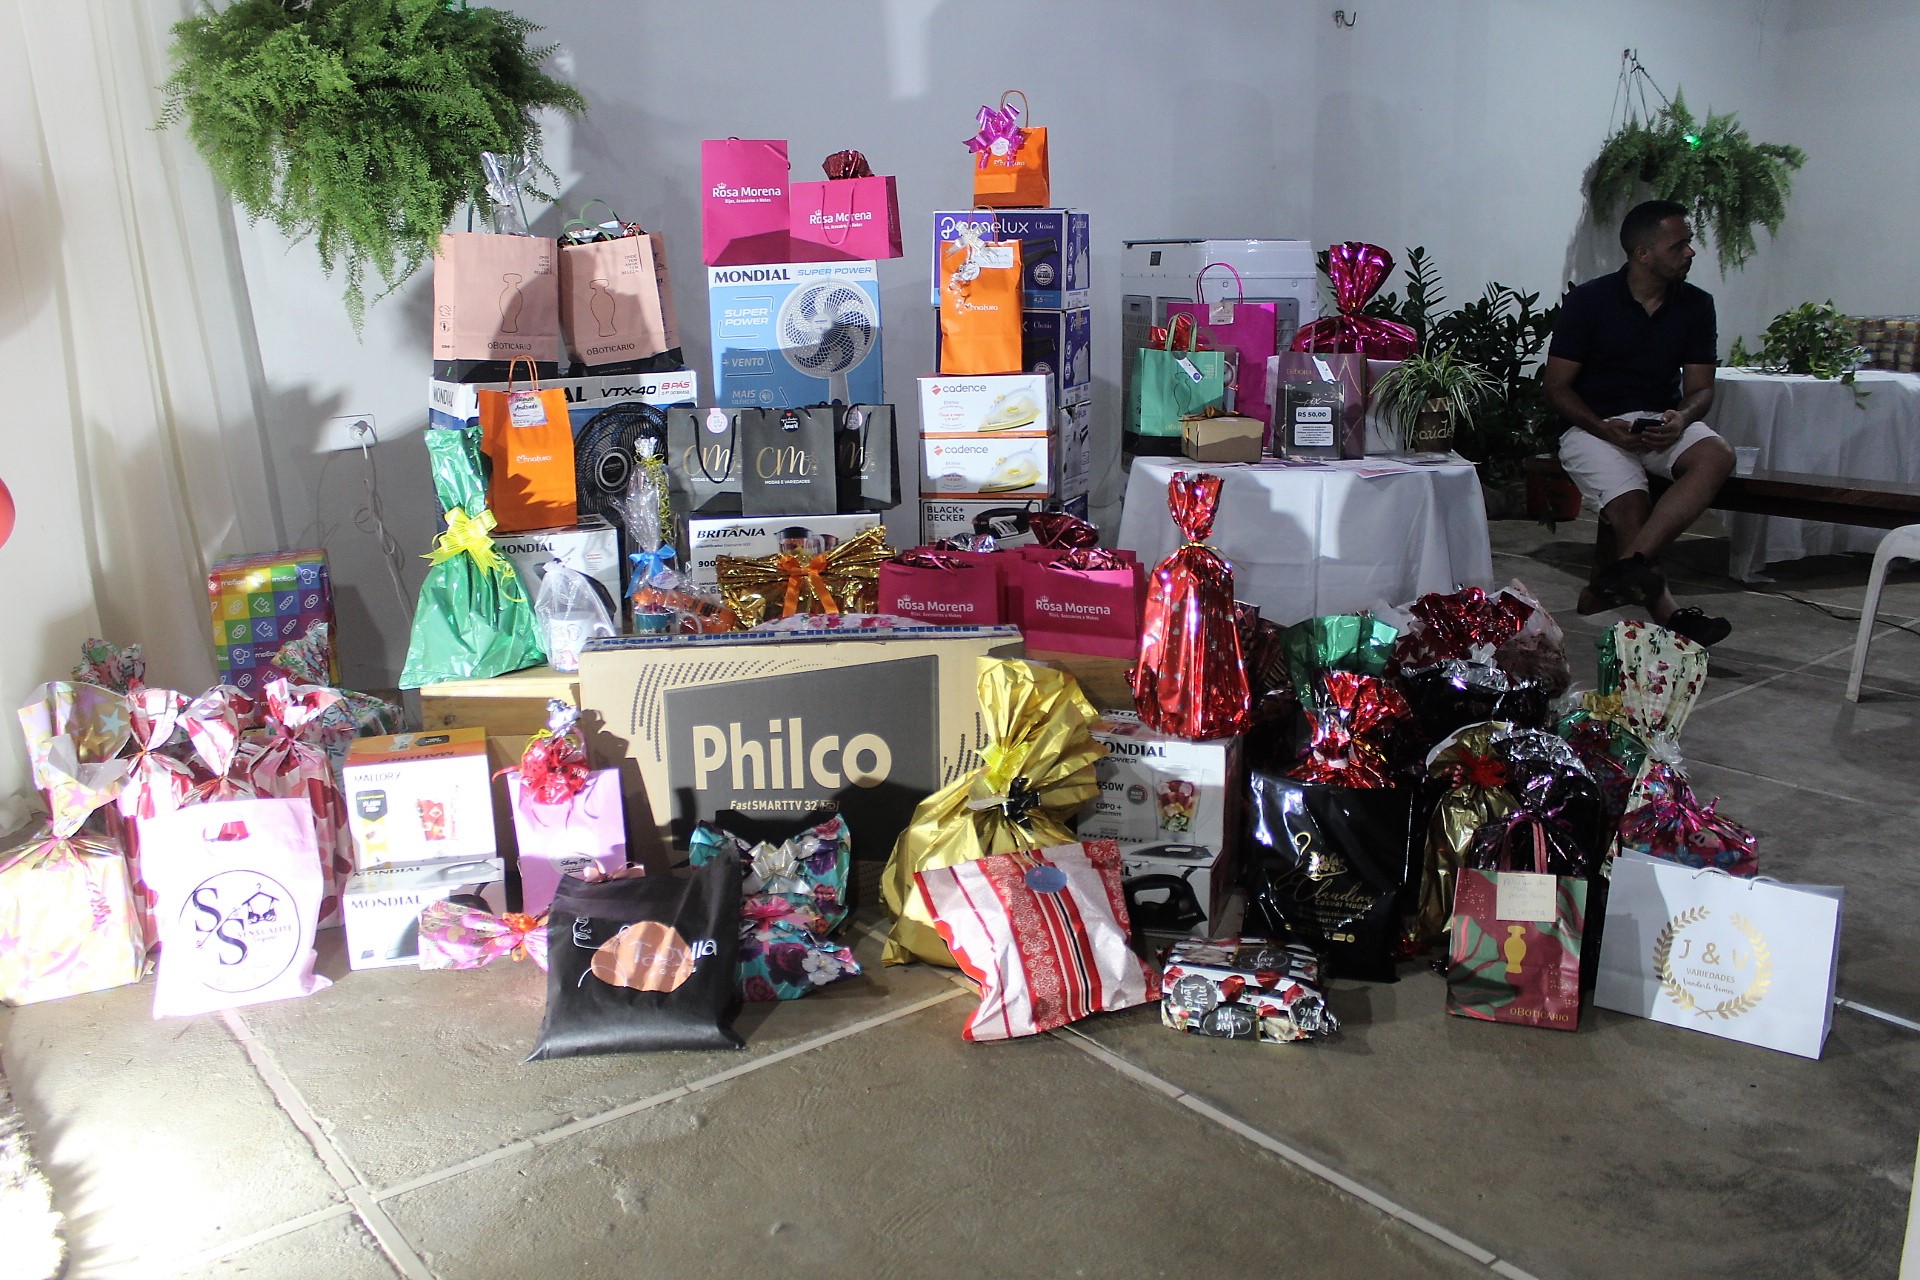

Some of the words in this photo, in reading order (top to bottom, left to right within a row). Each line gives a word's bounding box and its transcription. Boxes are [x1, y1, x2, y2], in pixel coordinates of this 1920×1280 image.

[712, 187, 739, 198] Rosa
[741, 186, 781, 197] Morena
[809, 214, 834, 225] Rosa
[714, 268, 791, 284] MONDIAL
[797, 268, 832, 276] SUPER
[834, 266, 872, 275] POWER
[724, 308, 768, 318] SUPER
[725, 318, 769, 326] POWER
[732, 358, 764, 368] VENTO
[600, 384, 657, 398] VTX-40
[661, 382, 670, 390] 8
[671, 380, 690, 389] PÁS
[732, 389, 756, 398] MAIS
[942, 384, 987, 393] cadence
[944, 445, 988, 454] cadence
[926, 506, 964, 514] BLACK+
[926, 514, 965, 522] DECKER
[897, 598, 926, 611] Rosa
[927, 600, 974, 612] Morena
[1036, 598, 1063, 612] Rosa
[1064, 602, 1111, 616] Morena
[692, 717, 892, 791] Philco
[1097, 741, 1167, 758] ONDIAL
[730, 800, 751, 810] Fast
[1096, 802, 1116, 810] COPO
[353, 867, 423, 877] MONDIAL
[352, 895, 422, 909] MONDIAL
[1679, 939, 1692, 960] J
[1702, 942, 1720, 966] &
[1686, 967, 1735, 984] VARIEDADES
